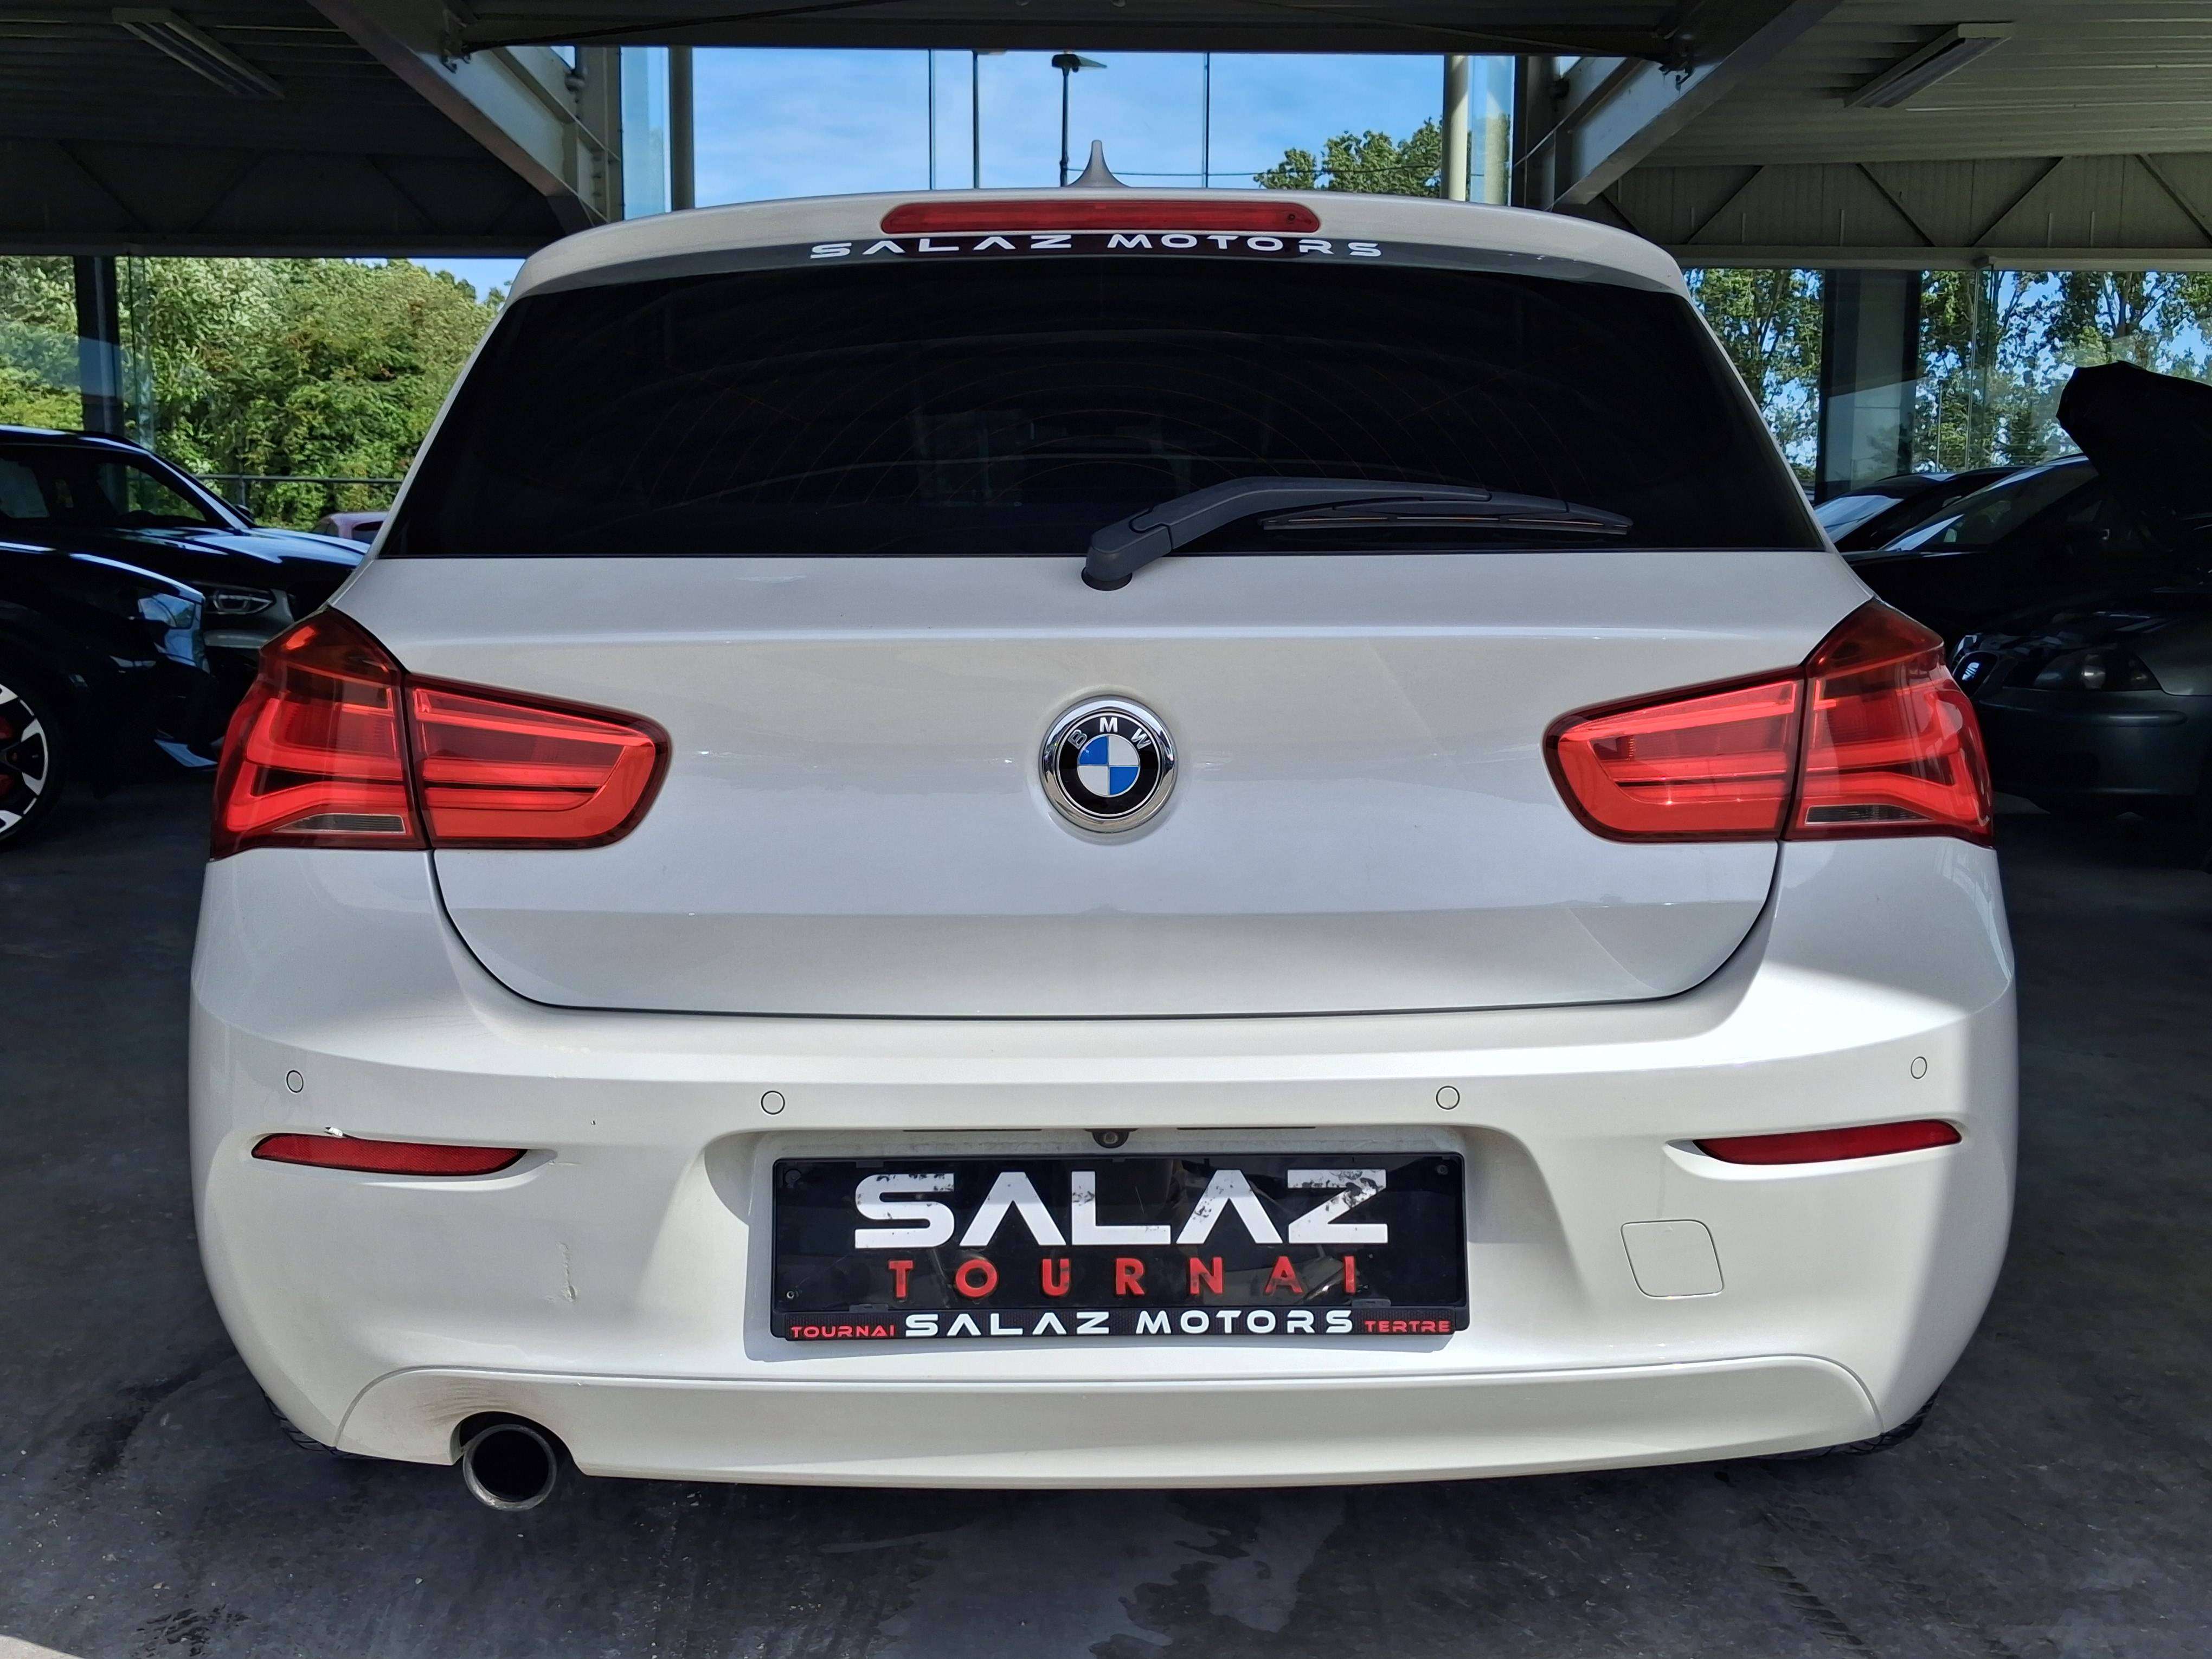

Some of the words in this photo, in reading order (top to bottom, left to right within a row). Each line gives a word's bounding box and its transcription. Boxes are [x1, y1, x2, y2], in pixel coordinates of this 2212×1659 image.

[809, 234, 1071, 259] SALAZ
[1107, 233, 1381, 257] MOTORS
[1068, 717, 1151, 750] BMW
[854, 1169, 1388, 1248] SALAZ
[889, 1256, 1356, 1297] TOURNAI
[791, 1324, 895, 1338] TOURNAI
[905, 1311, 1109, 1336] SALAZ
[1136, 1310, 1353, 1334] MOTORS
[1364, 1320, 1450, 1333] TERTRE
